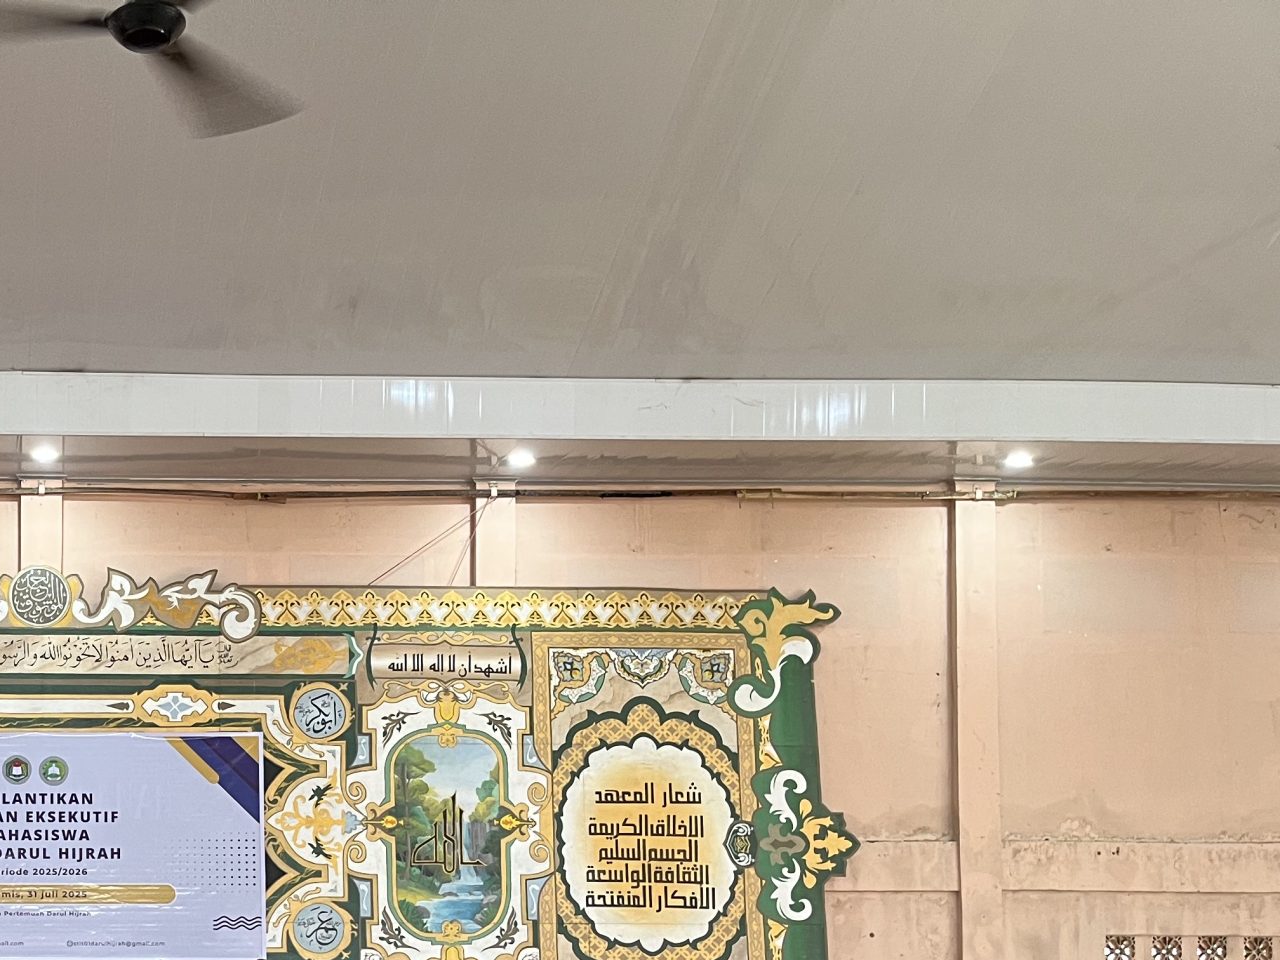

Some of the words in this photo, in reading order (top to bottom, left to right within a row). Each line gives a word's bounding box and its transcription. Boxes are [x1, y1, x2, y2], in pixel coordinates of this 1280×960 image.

[25, 811, 119, 823] EKSEKUTIF
[58, 847, 122, 862] HIJRAH
[32, 867, 88, 877] 2025/2026
[27, 890, 38, 899] 31
[61, 890, 88, 899] 2025
